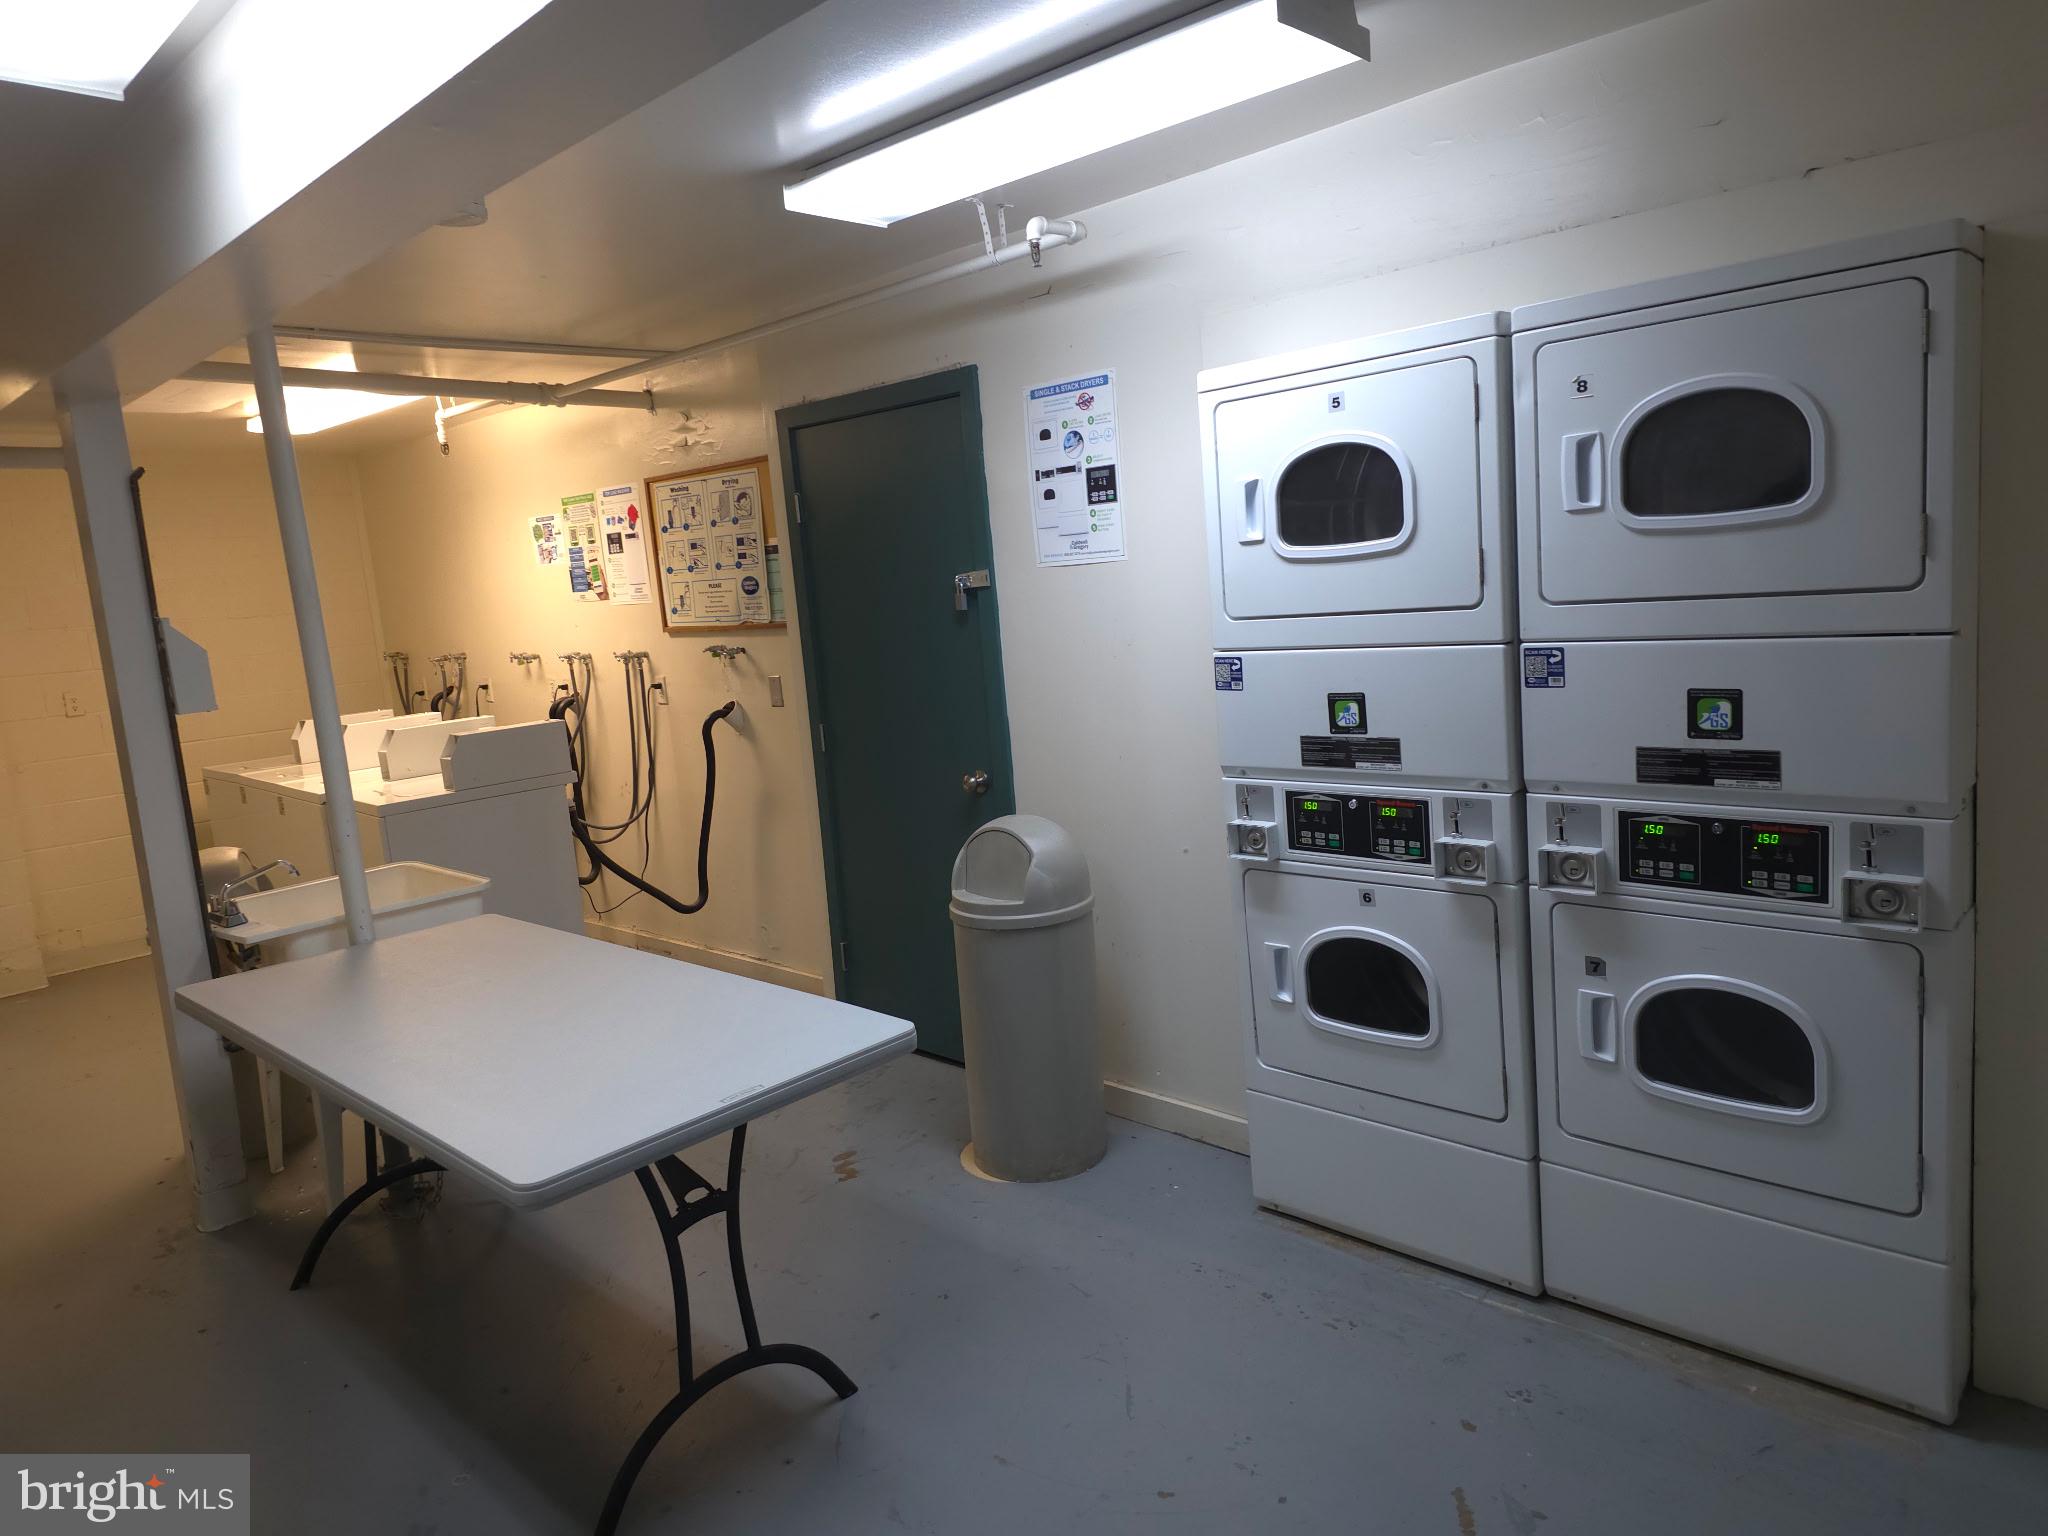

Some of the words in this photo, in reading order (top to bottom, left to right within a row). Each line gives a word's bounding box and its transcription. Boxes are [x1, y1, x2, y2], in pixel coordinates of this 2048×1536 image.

[1034, 388, 1055, 398] SINGLE
[1061, 381, 1080, 392] STACK
[1081, 377, 1104, 388] DRYERS
[1577, 380, 1588, 393] 8
[1332, 396, 1341, 409] 5
[1363, 892, 1372, 903] 6
[1590, 961, 1601, 972] 7
